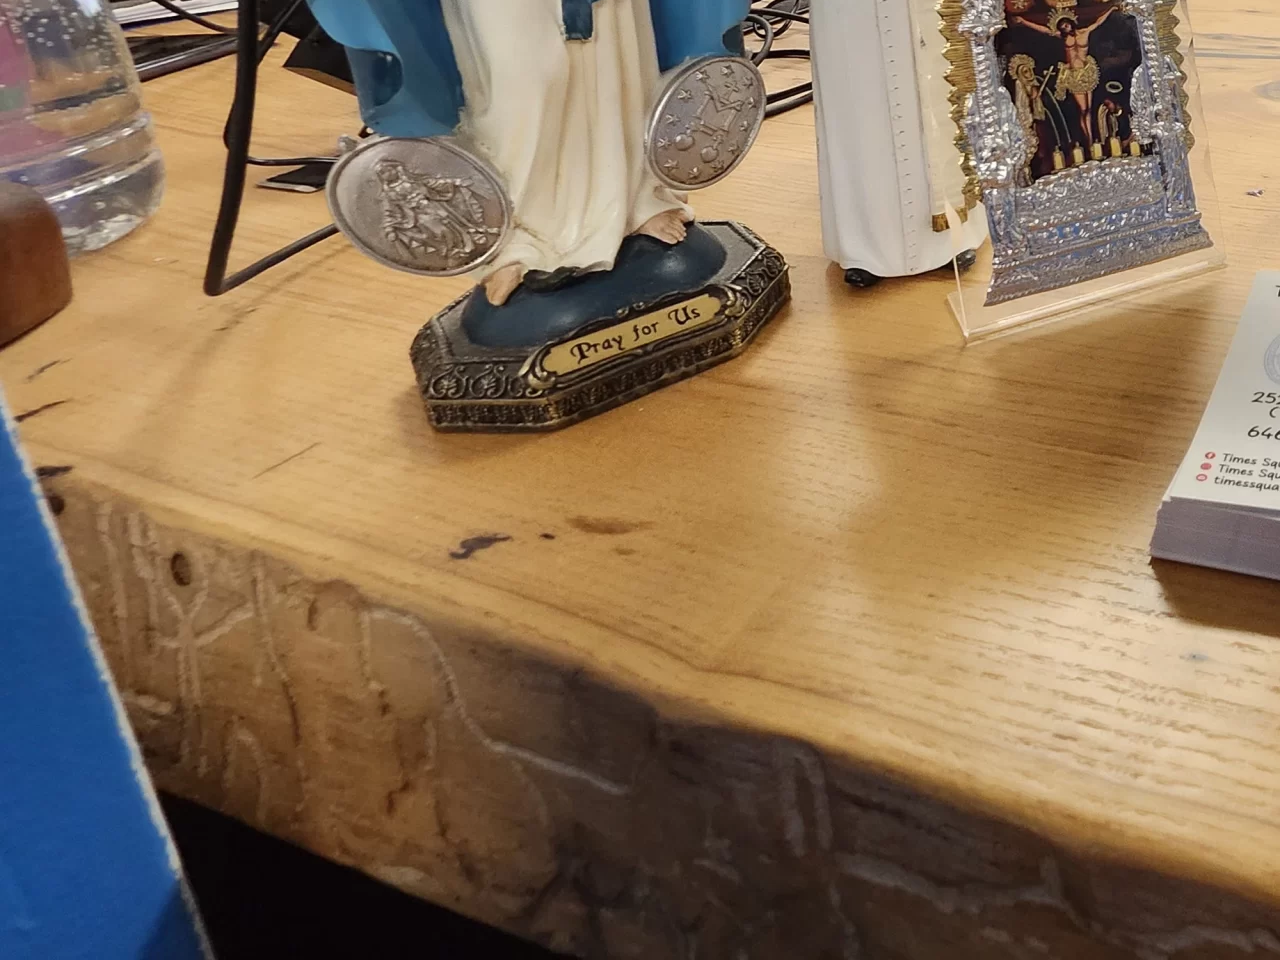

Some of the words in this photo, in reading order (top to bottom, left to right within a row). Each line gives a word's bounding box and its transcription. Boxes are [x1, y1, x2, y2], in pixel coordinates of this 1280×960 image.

[570, 335, 626, 365] Pray
[632, 321, 659, 342] for
[667, 305, 701, 326] Us
[1222, 453, 1257, 466] Times
[1218, 463, 1253, 477] Times
